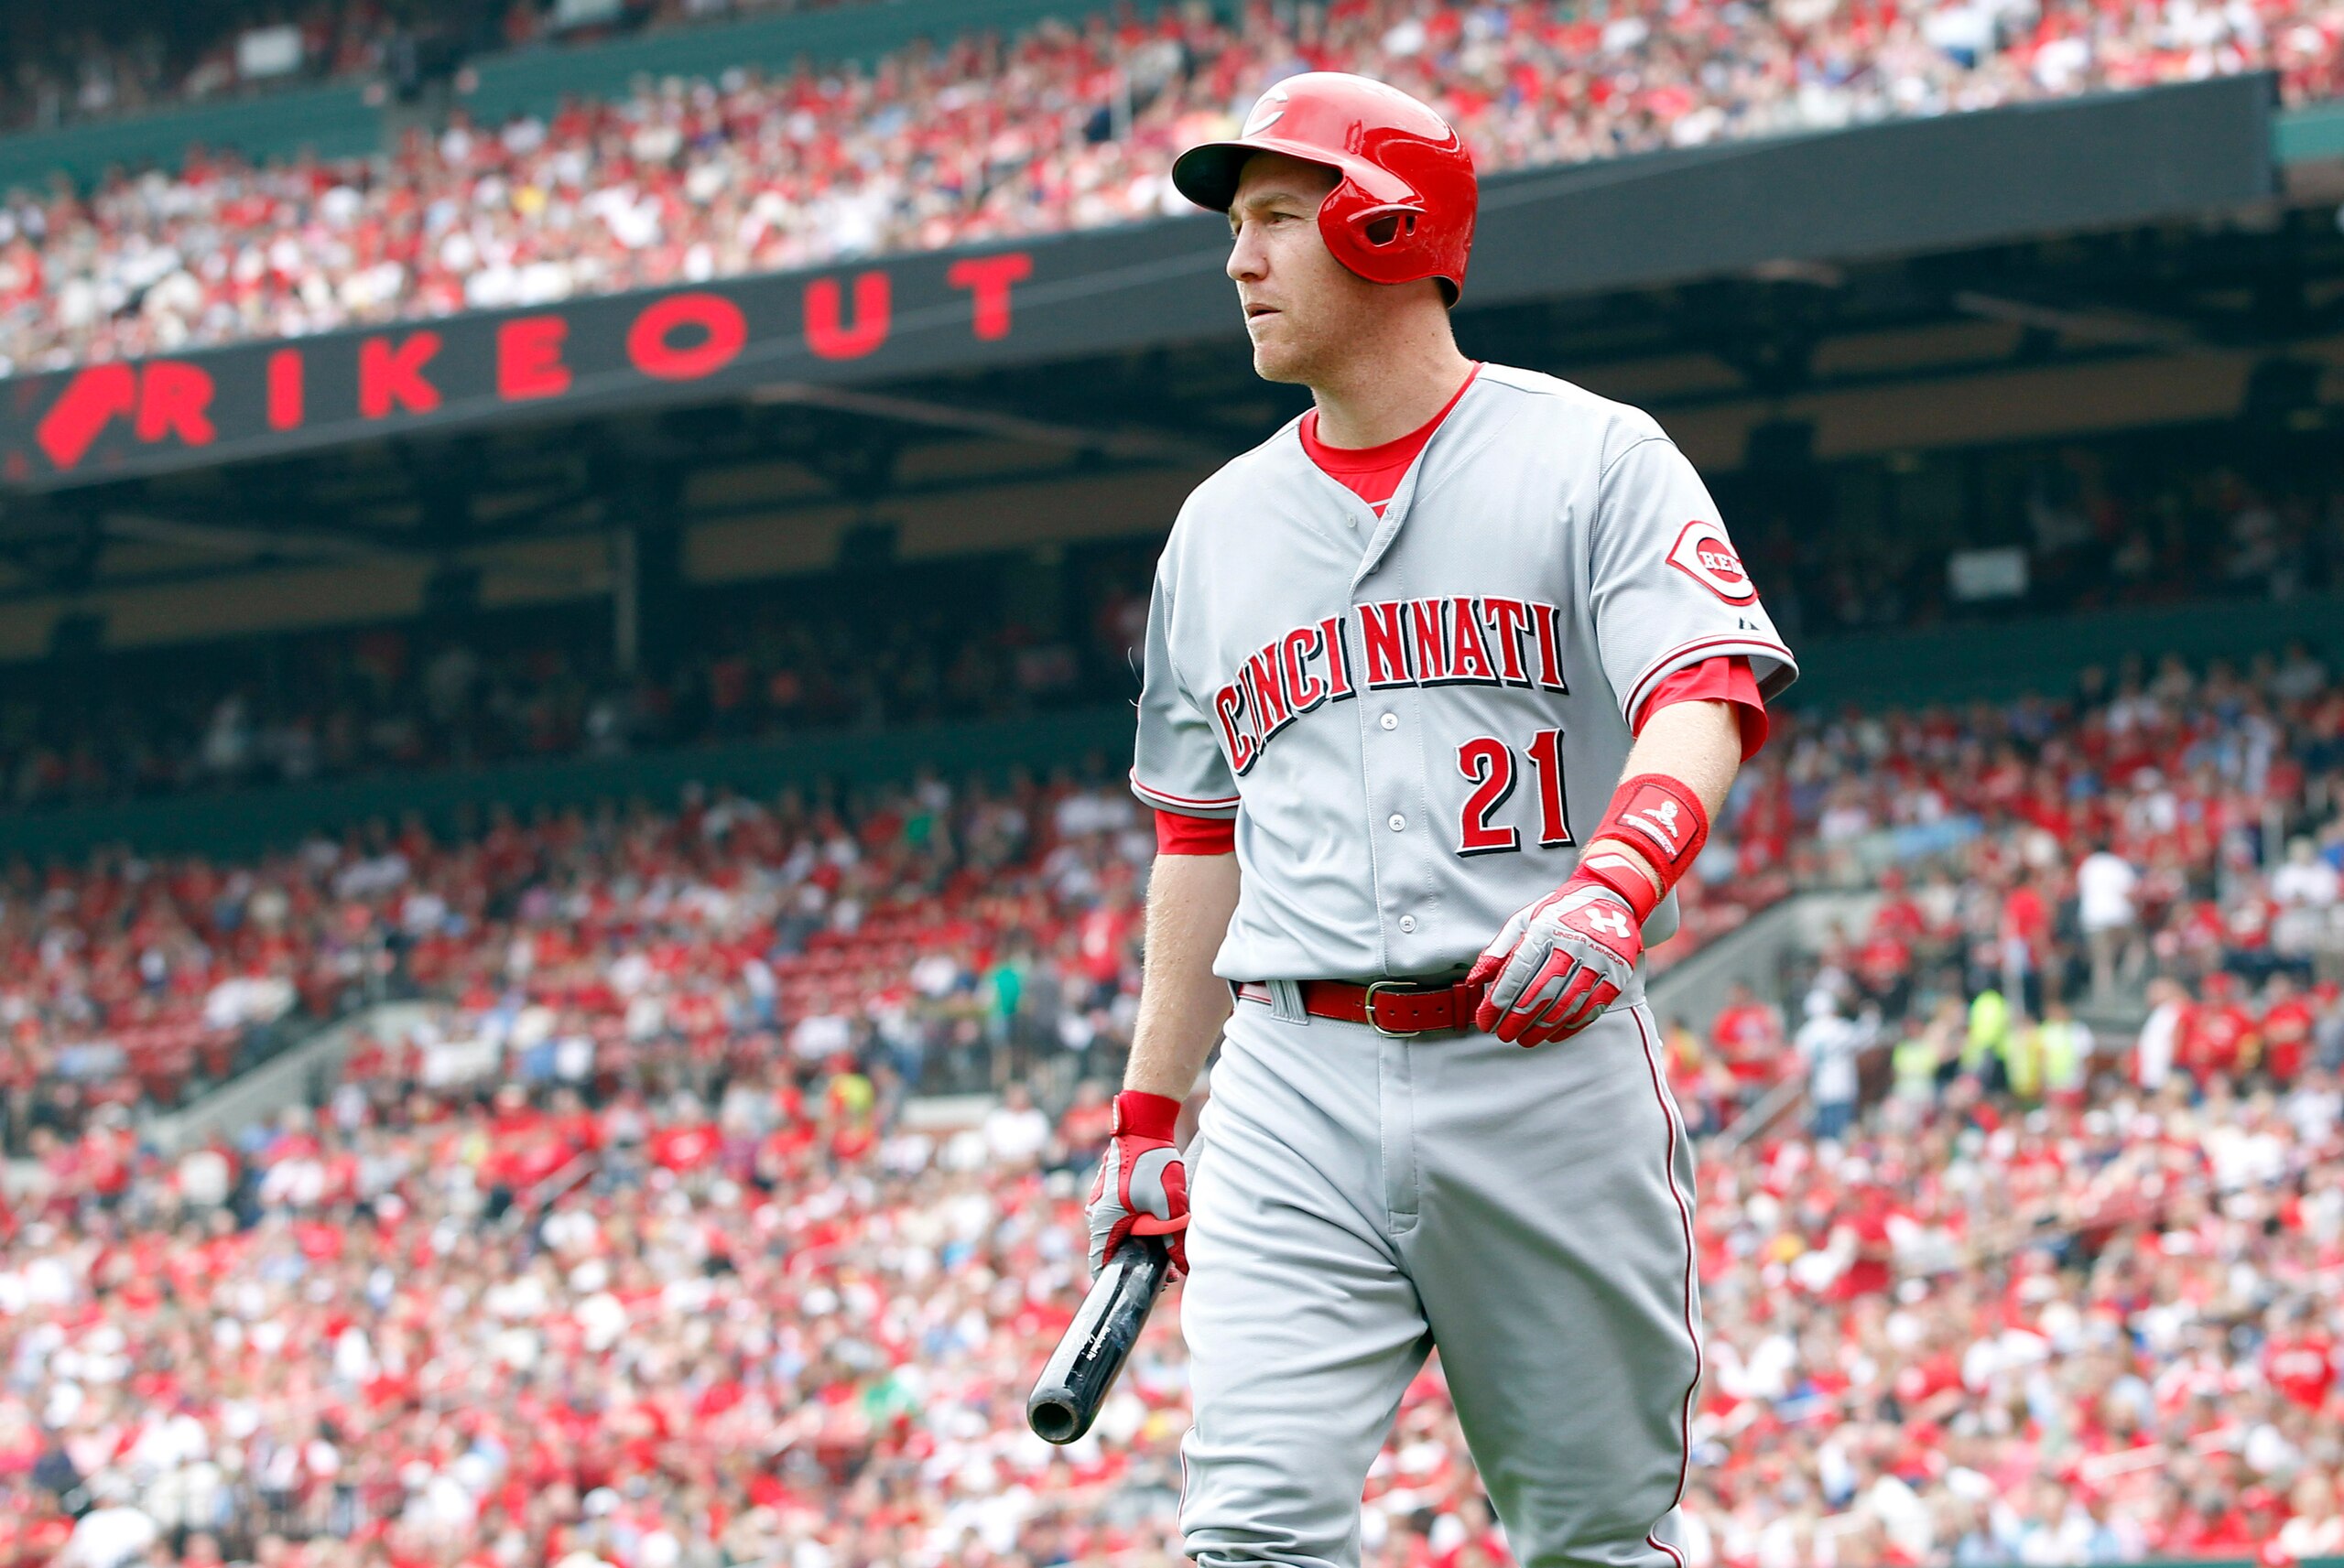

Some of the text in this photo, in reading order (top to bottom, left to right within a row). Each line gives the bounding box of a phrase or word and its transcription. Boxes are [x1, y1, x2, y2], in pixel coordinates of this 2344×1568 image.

[1214, 594, 1569, 776] CINCINNATI
[1455, 727, 1576, 858] 21
[1553, 929, 1624, 967] UNDER ARMOUR
